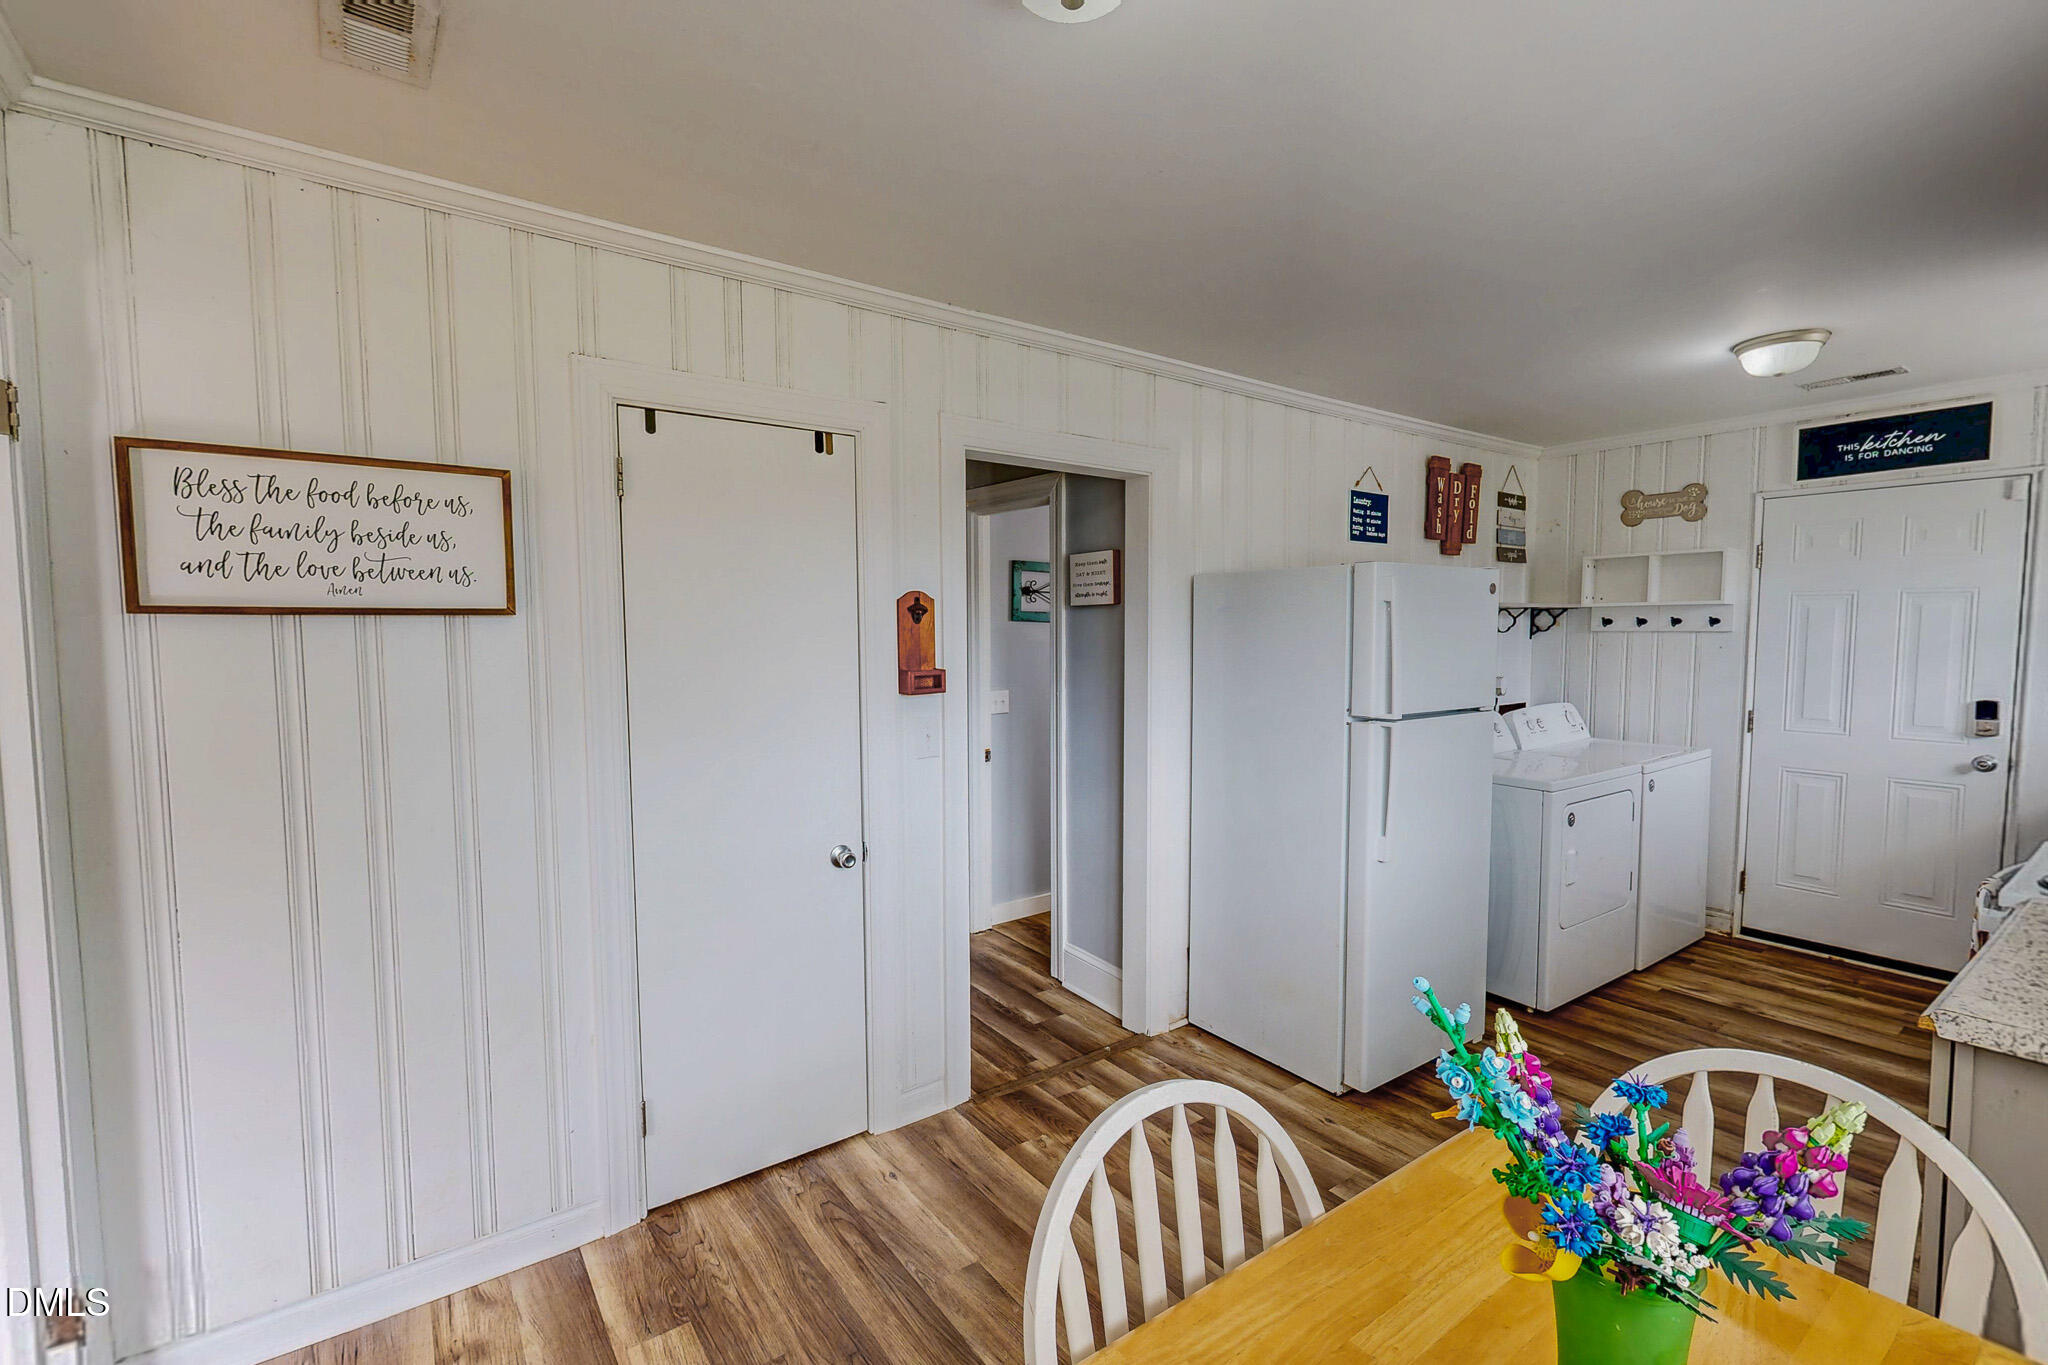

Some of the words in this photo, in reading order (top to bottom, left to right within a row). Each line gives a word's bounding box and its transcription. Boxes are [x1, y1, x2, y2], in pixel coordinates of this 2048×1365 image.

[1837, 443, 1860, 452] THIS
[1860, 429, 1947, 452] kitchen
[1844, 454, 1854, 462] IS
[1858, 451, 1880, 460] FOR
[1883, 444, 1934, 457] DANCING
[173, 466, 248, 504] Bless
[247, 473, 301, 505] the
[306, 477, 360, 509] food
[366, 482, 440, 516] before
[444, 495, 474, 518] us,
[1436, 477, 1446, 534] Wash
[1453, 481, 1462, 524] Dry
[1466, 484, 1478, 540] Fold
[1673, 502, 1698, 517] Dog
[176, 505, 245, 542] the
[249, 512, 345, 554] family
[350, 519, 422, 550] beside
[426, 530, 457, 553] us,
[179, 550, 234, 580] and
[235, 551, 290, 583] the
[296, 550, 347, 580] love
[352, 551, 443, 585] between
[448, 566, 477, 588] us.
[326, 582, 364, 598] Amen
